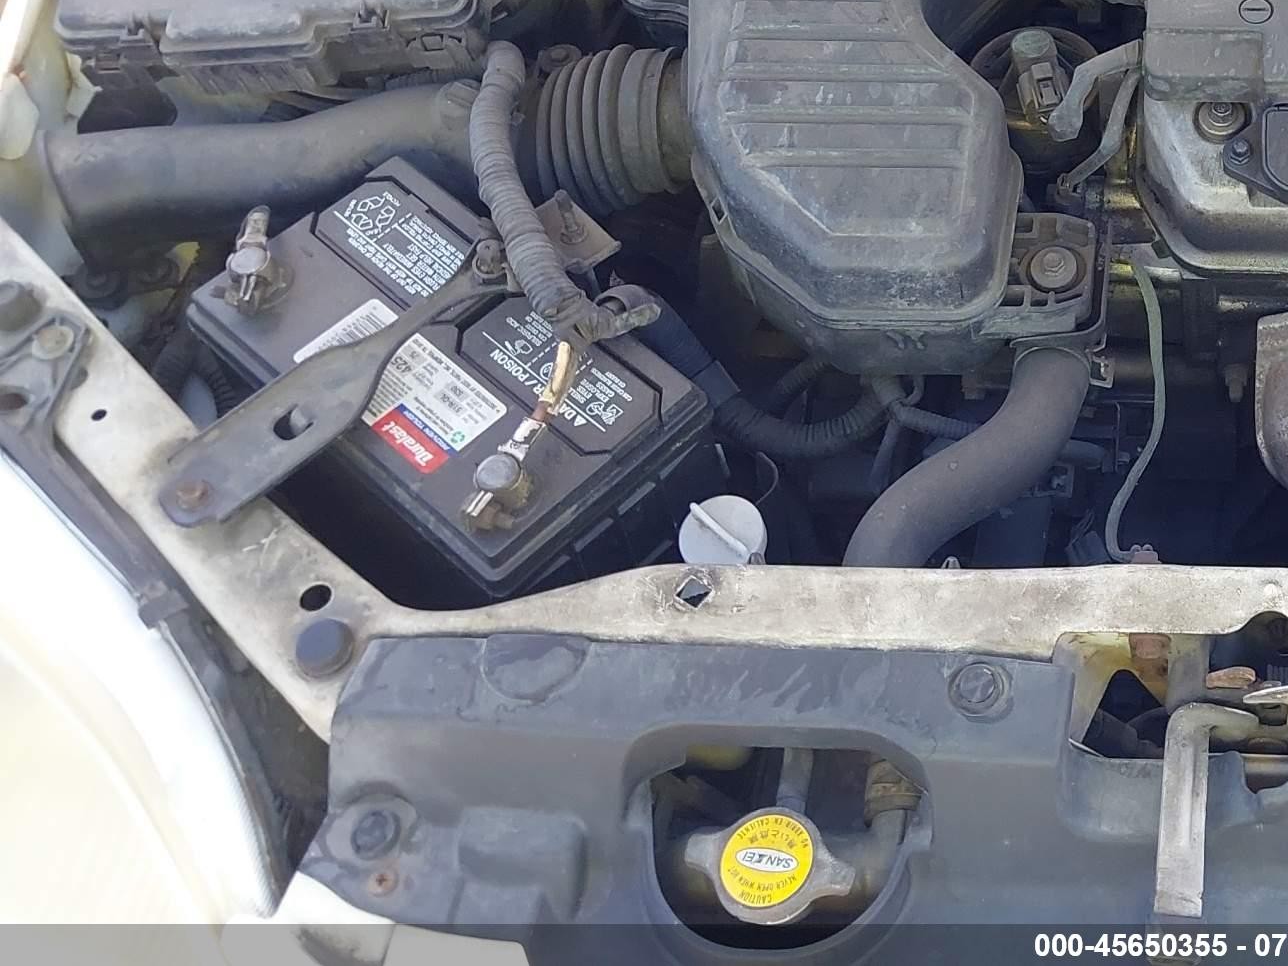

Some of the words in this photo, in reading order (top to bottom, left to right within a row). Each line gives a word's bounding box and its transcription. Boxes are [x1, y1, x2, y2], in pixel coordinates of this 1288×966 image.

[389, 354, 413, 375] 425
[489, 347, 530, 381] POISON
[380, 418, 435, 467] Duralast
[736, 889, 772, 904] CAUTION
